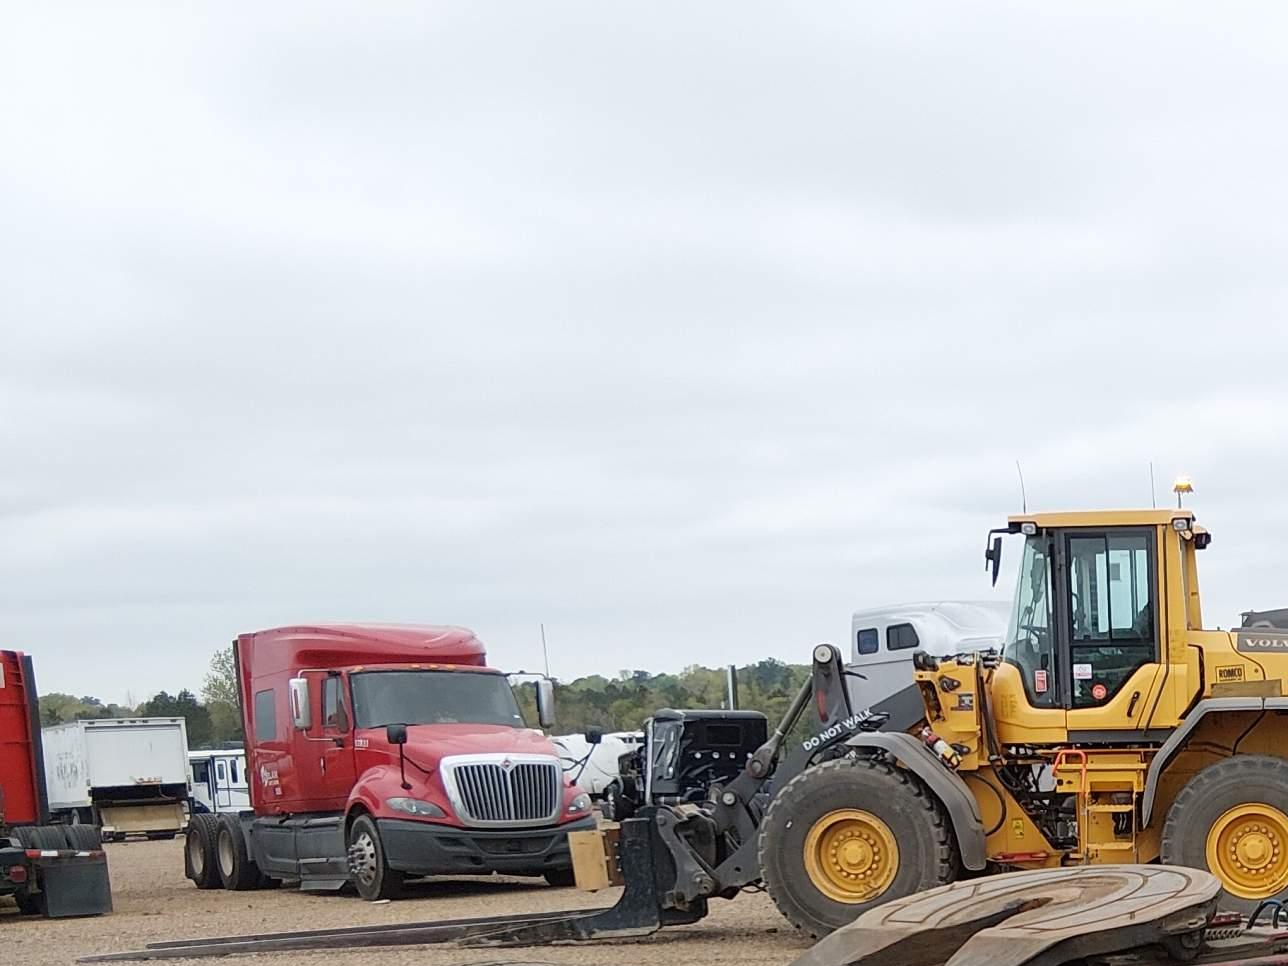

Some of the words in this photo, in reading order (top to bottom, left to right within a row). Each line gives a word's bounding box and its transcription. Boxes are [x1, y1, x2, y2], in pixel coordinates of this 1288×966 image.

[1218, 667, 1243, 678] ROMCO
[802, 737, 820, 751] DO
[819, 723, 843, 742] NOT
[841, 707, 874, 730] WALK
